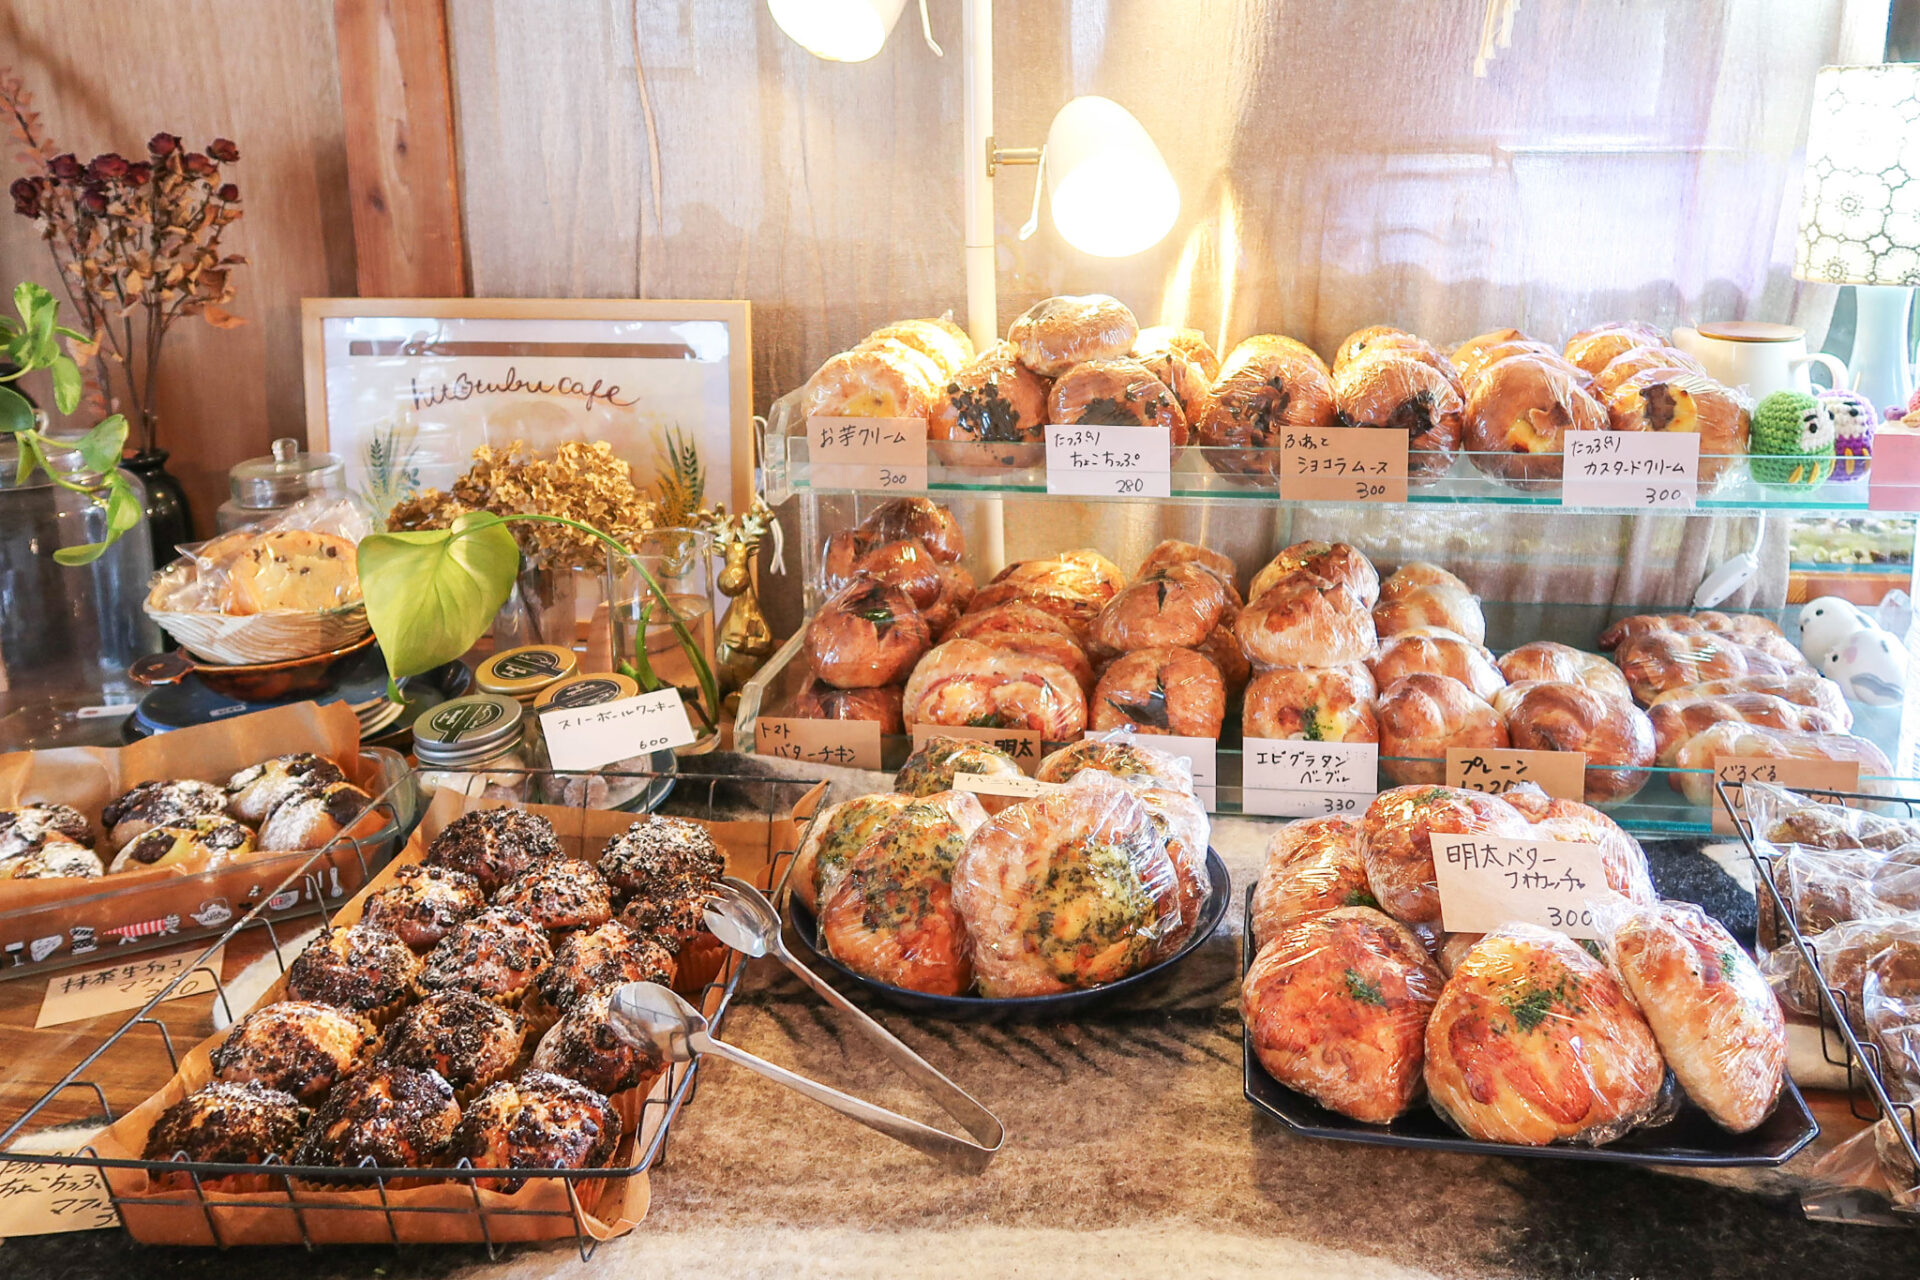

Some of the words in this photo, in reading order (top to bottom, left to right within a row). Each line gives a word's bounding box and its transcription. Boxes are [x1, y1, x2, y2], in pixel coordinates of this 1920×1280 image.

[557, 376, 641, 411] cafe
[819, 424, 906, 448] お芋クリーム
[1055, 430, 1101, 447] たっぷり
[1571, 435, 1621, 457] たっぷり
[1070, 450, 1141, 468] ちょこちっぷ
[1297, 456, 1389, 476] ショコラムース
[1583, 458, 1685, 476] カスタードクリーム
[879, 468, 907, 488] 300
[1115, 477, 1144, 494] 280
[1356, 481, 1387, 500] 300
[1645, 487, 1682, 505] 300
[761, 722, 791, 739] トマト
[639, 736, 669, 750] 600
[774, 743, 856, 763] バターチキン
[1256, 750, 1347, 769] エビグラタン
[1460, 756, 1528, 776] プレーン
[1719, 765, 1777, 782] ぐるぐる
[1300, 770, 1350, 785] ベーグル
[1324, 798, 1356, 813] 330
[1446, 842, 1557, 871] 明太バター
[1547, 907, 1594, 927] 300
